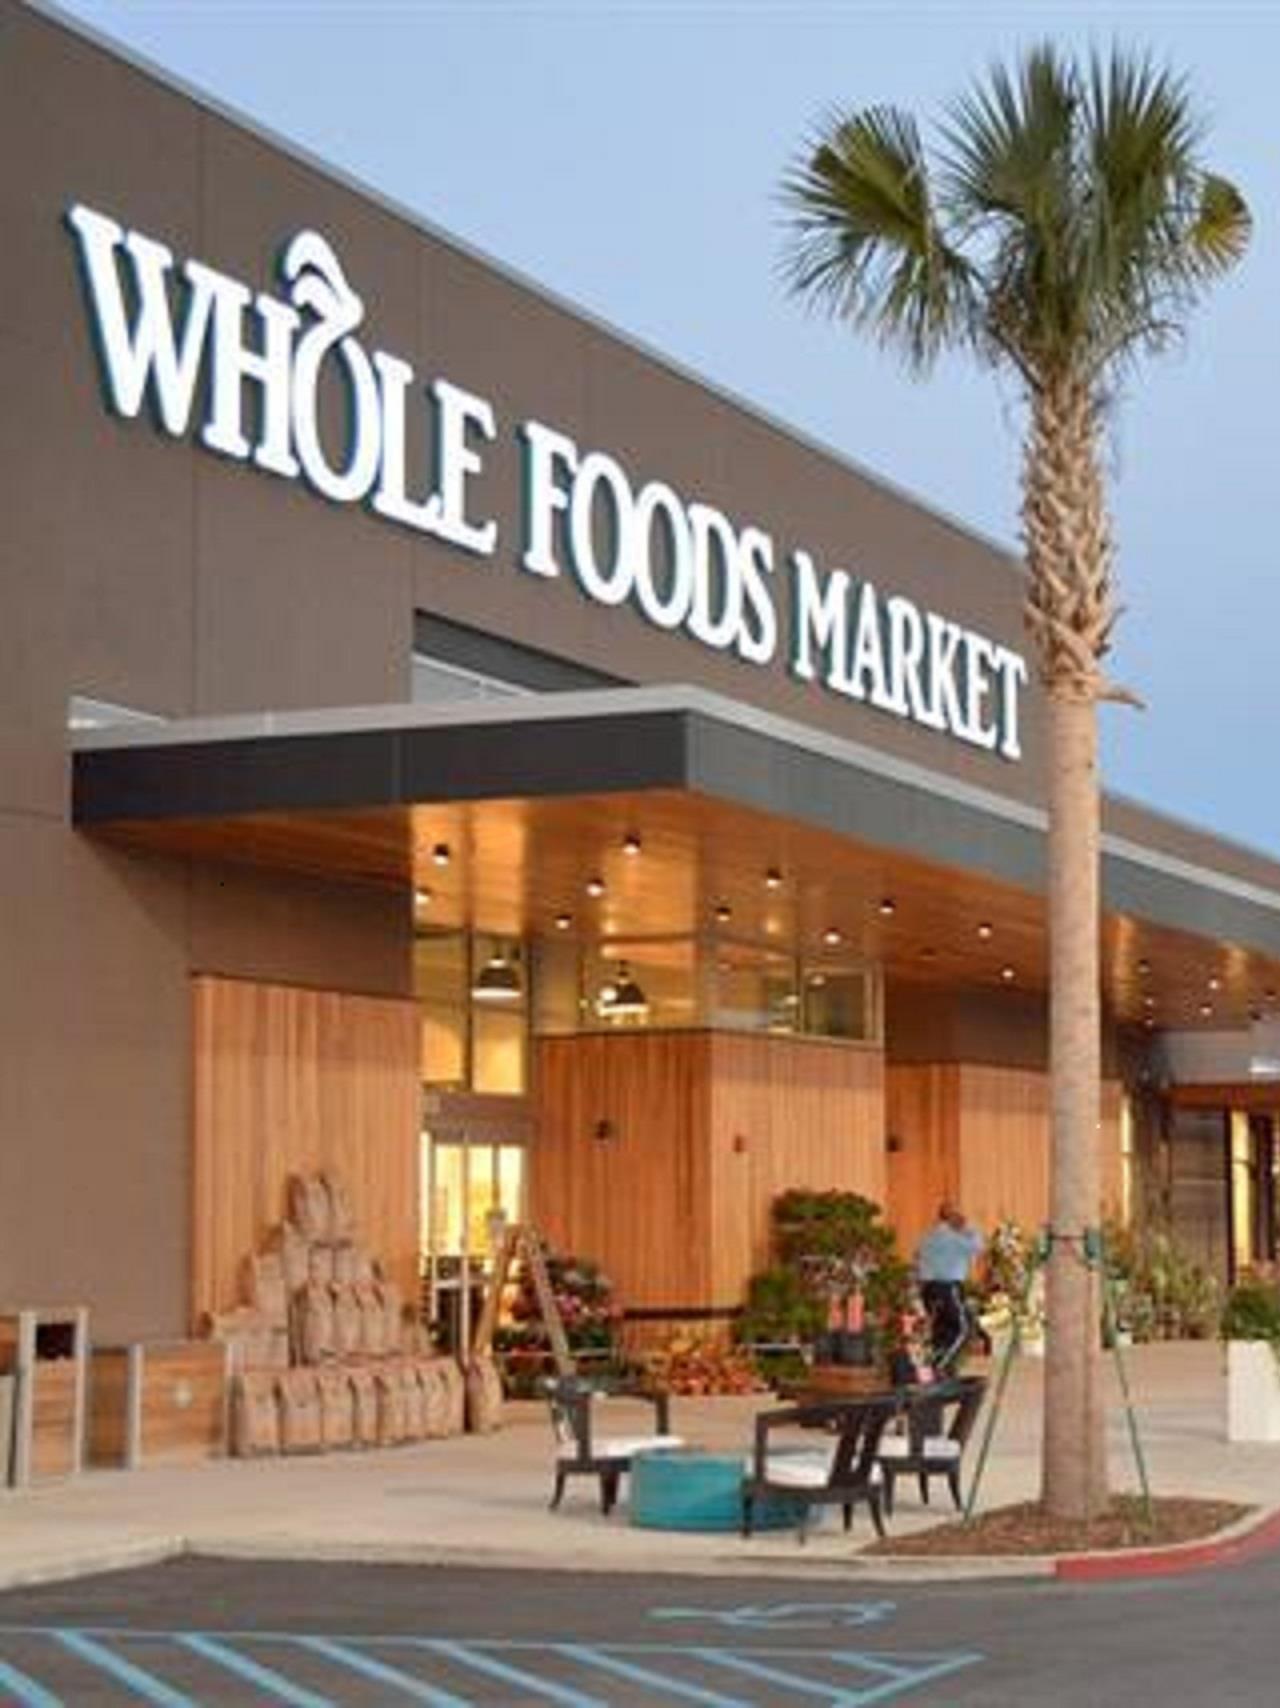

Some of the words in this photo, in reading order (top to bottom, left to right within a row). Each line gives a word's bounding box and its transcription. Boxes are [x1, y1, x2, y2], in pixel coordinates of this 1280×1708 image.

[68, 205, 498, 554] WHOLE
[524, 421, 777, 664] FOODS
[794, 549, 1029, 760] MARKET
